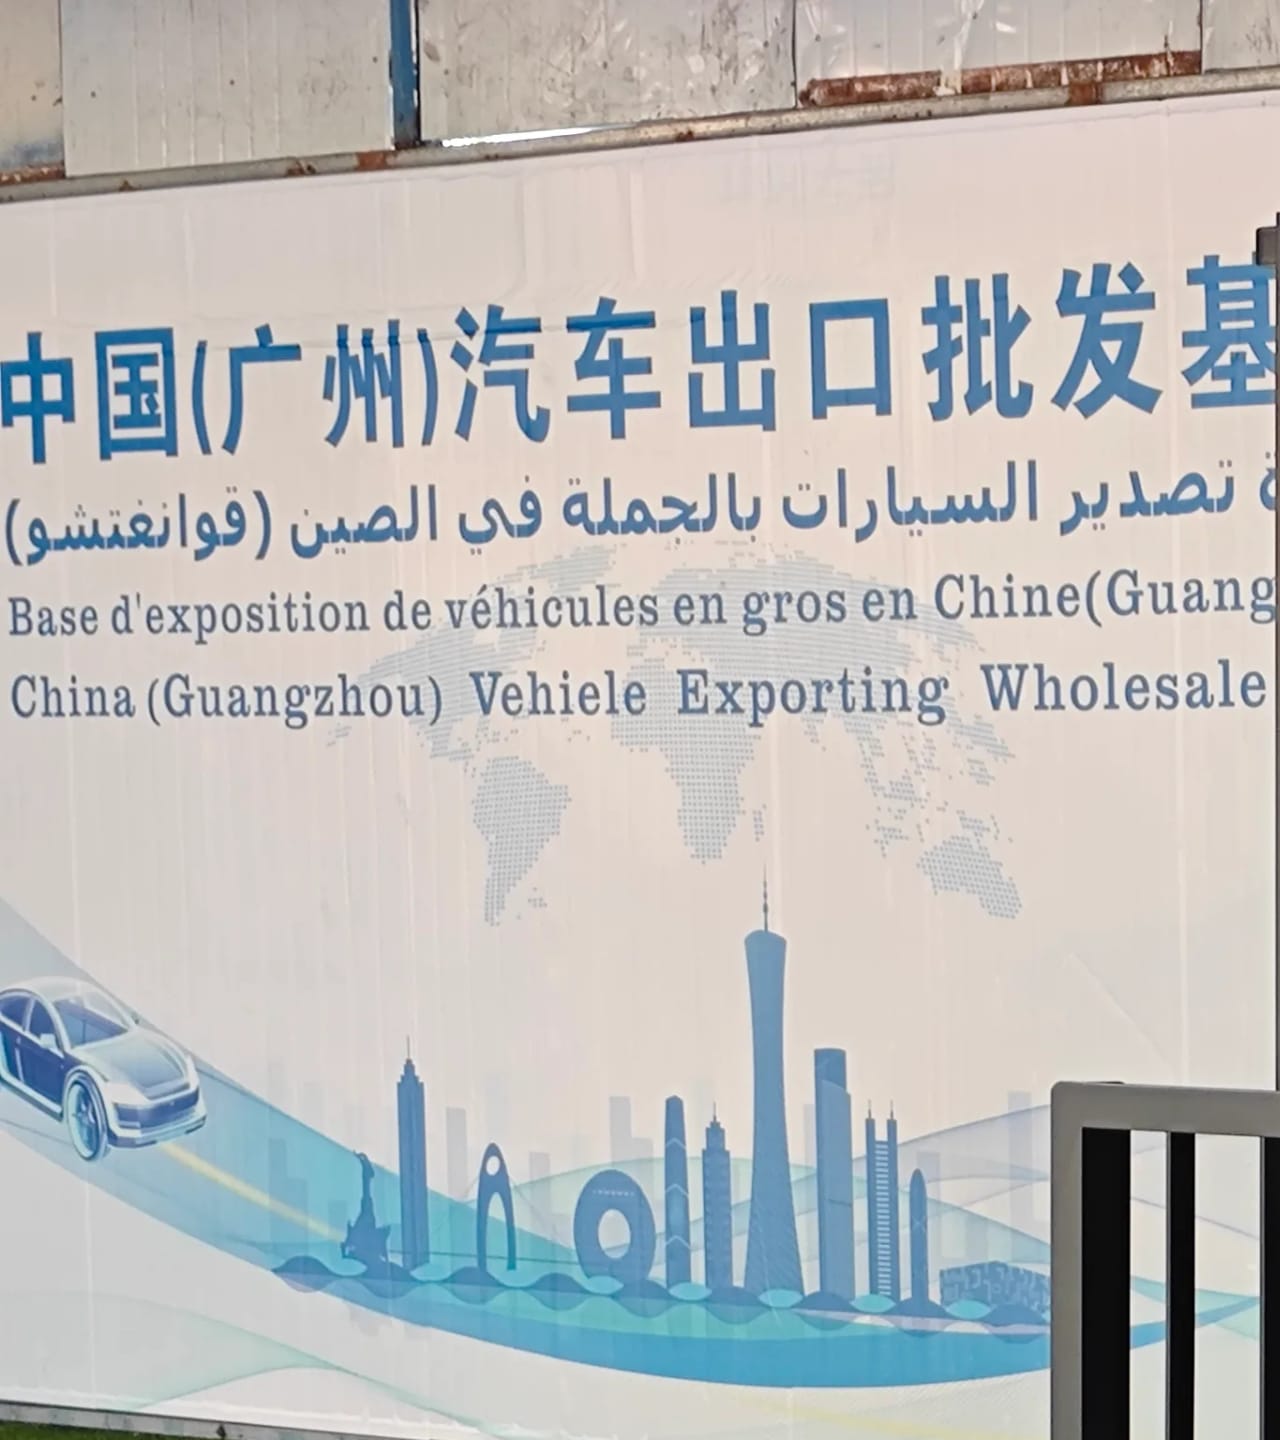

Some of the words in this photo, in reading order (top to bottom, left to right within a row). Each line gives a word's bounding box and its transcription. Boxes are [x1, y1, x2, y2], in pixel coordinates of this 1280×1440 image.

[290, 484, 438, 559] الصين
[458, 475, 543, 555] في
[562, 472, 761, 544] بالجملة
[782, 459, 1037, 542] السيارات
[1059, 460, 1234, 536] تصدير
[9, 596, 98, 637] Base
[112, 591, 370, 644] d'exposition
[384, 590, 432, 631] de
[445, 584, 660, 630] véhicules
[673, 592, 727, 626] en
[743, 588, 847, 637] gros
[863, 587, 918, 622] en
[11, 673, 136, 719] China
[147, 673, 443, 729] (Guangzhou)
[470, 669, 647, 717] Vehiele
[676, 664, 949, 728] Exporting
[980, 659, 1267, 712] Wholesale
